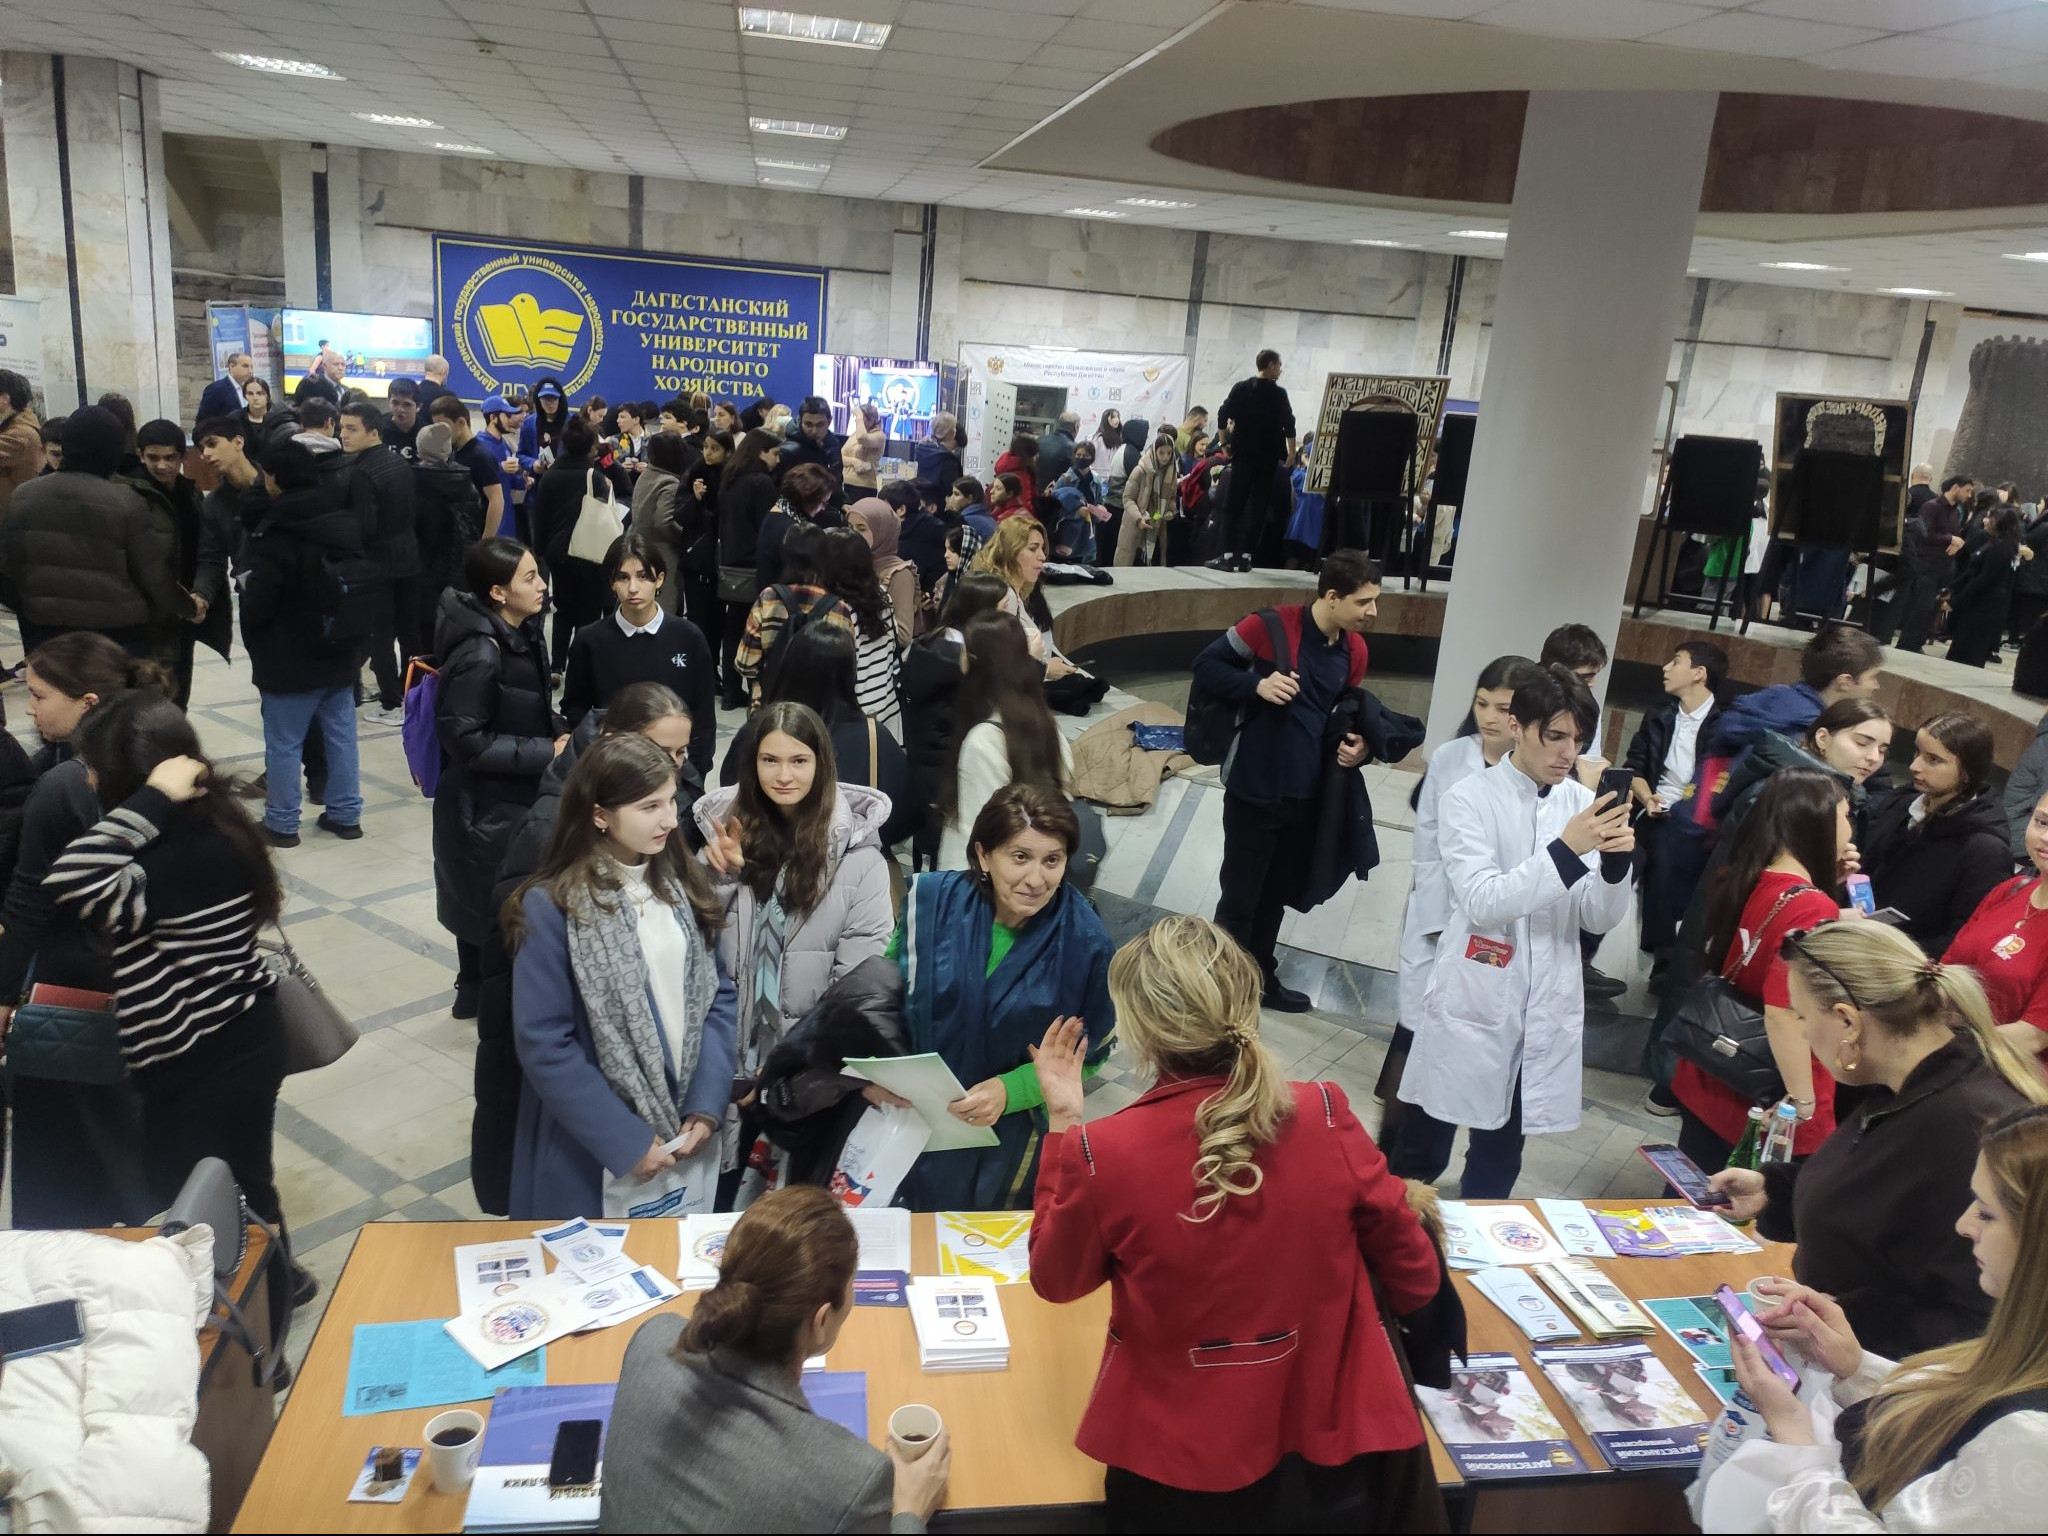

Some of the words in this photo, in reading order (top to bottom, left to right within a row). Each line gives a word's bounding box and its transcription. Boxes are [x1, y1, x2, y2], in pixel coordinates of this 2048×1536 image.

[454, 253, 520, 321] государственный
[522, 254, 587, 293] университет
[585, 293, 604, 352] народного
[631, 290, 789, 318] ДАГЕСТАНСКИЙ
[611, 309, 808, 340] ГОСУДАРСТВЕННЫЙ
[640, 332, 780, 358] УНИВЕРСИТЕТ
[651, 354, 769, 378] НАРОДНОГО
[654, 375, 766, 398] ХОЗЯЙСТВА
[1465, 1459, 1552, 1472] ДАГЕСТАНСКИЙ
